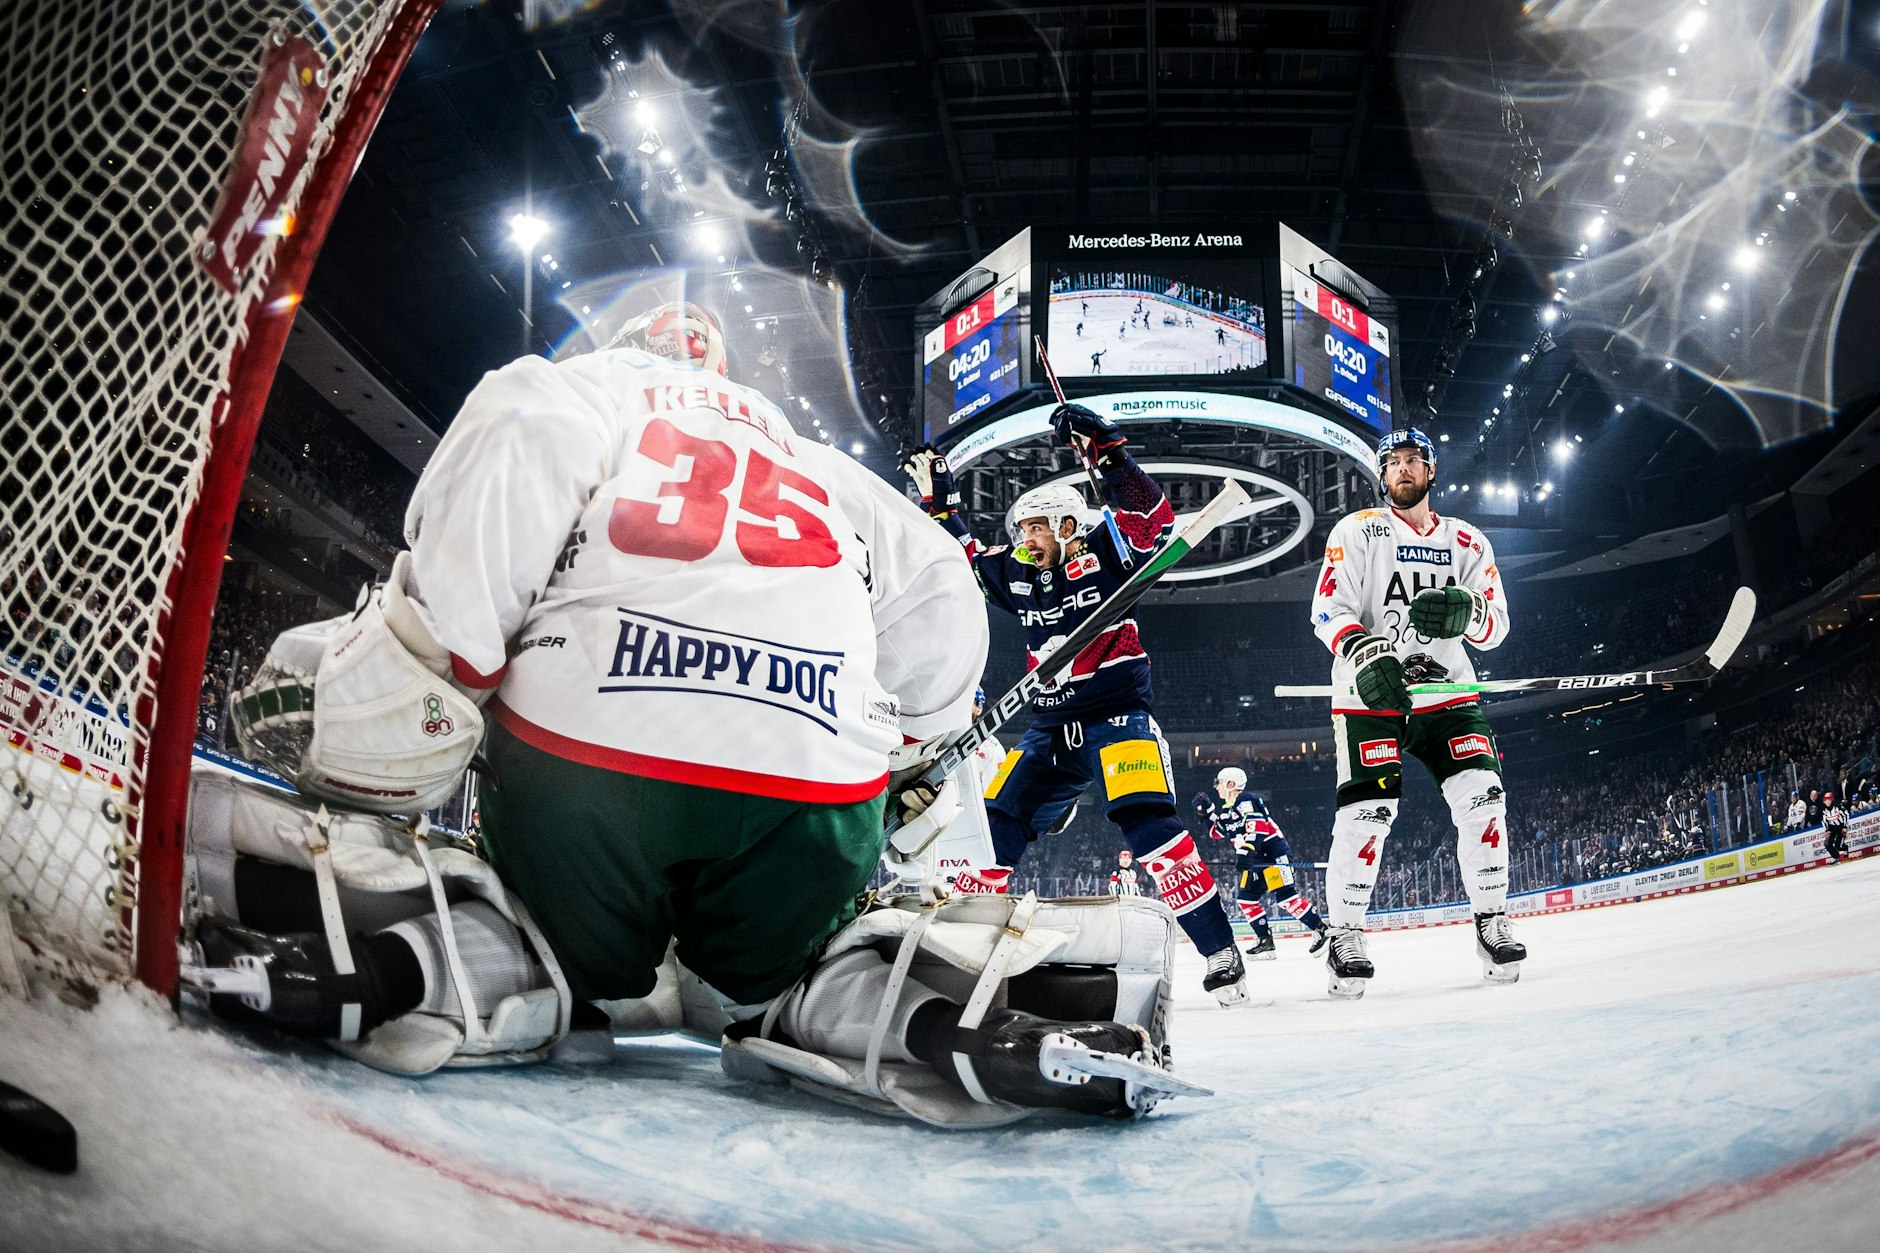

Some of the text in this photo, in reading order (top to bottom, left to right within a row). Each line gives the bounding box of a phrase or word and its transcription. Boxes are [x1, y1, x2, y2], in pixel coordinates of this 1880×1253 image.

[1068, 232, 1243, 249] Mercedes-Benz Arena
[957, 304, 981, 336] 0:1
[1331, 297, 1356, 330] 0:1
[948, 338, 990, 382] 04:20
[1324, 333, 1366, 375] 04:20
[948, 393, 991, 425] GASAG
[1112, 398, 1207, 413] amazon music
[1324, 387, 1368, 418] GASAG
[971, 430, 997, 450] music
[1322, 426, 1370, 461] amazon music
[608, 417, 842, 569] 35
[1398, 548, 1450, 564] HAIMER
[1318, 566, 1338, 598] 4
[608, 620, 839, 719] HAPPY DOG
[1557, 673, 1636, 690] BAUER
[940, 671, 1046, 777] BAUER
[1365, 745, 1398, 760] müller
[1455, 736, 1487, 754] müller
[232, 757, 255, 771] GASAG
[1117, 759, 1159, 774] Knittel
[1481, 816, 1500, 849] 4
[1358, 834, 1376, 866] 4
